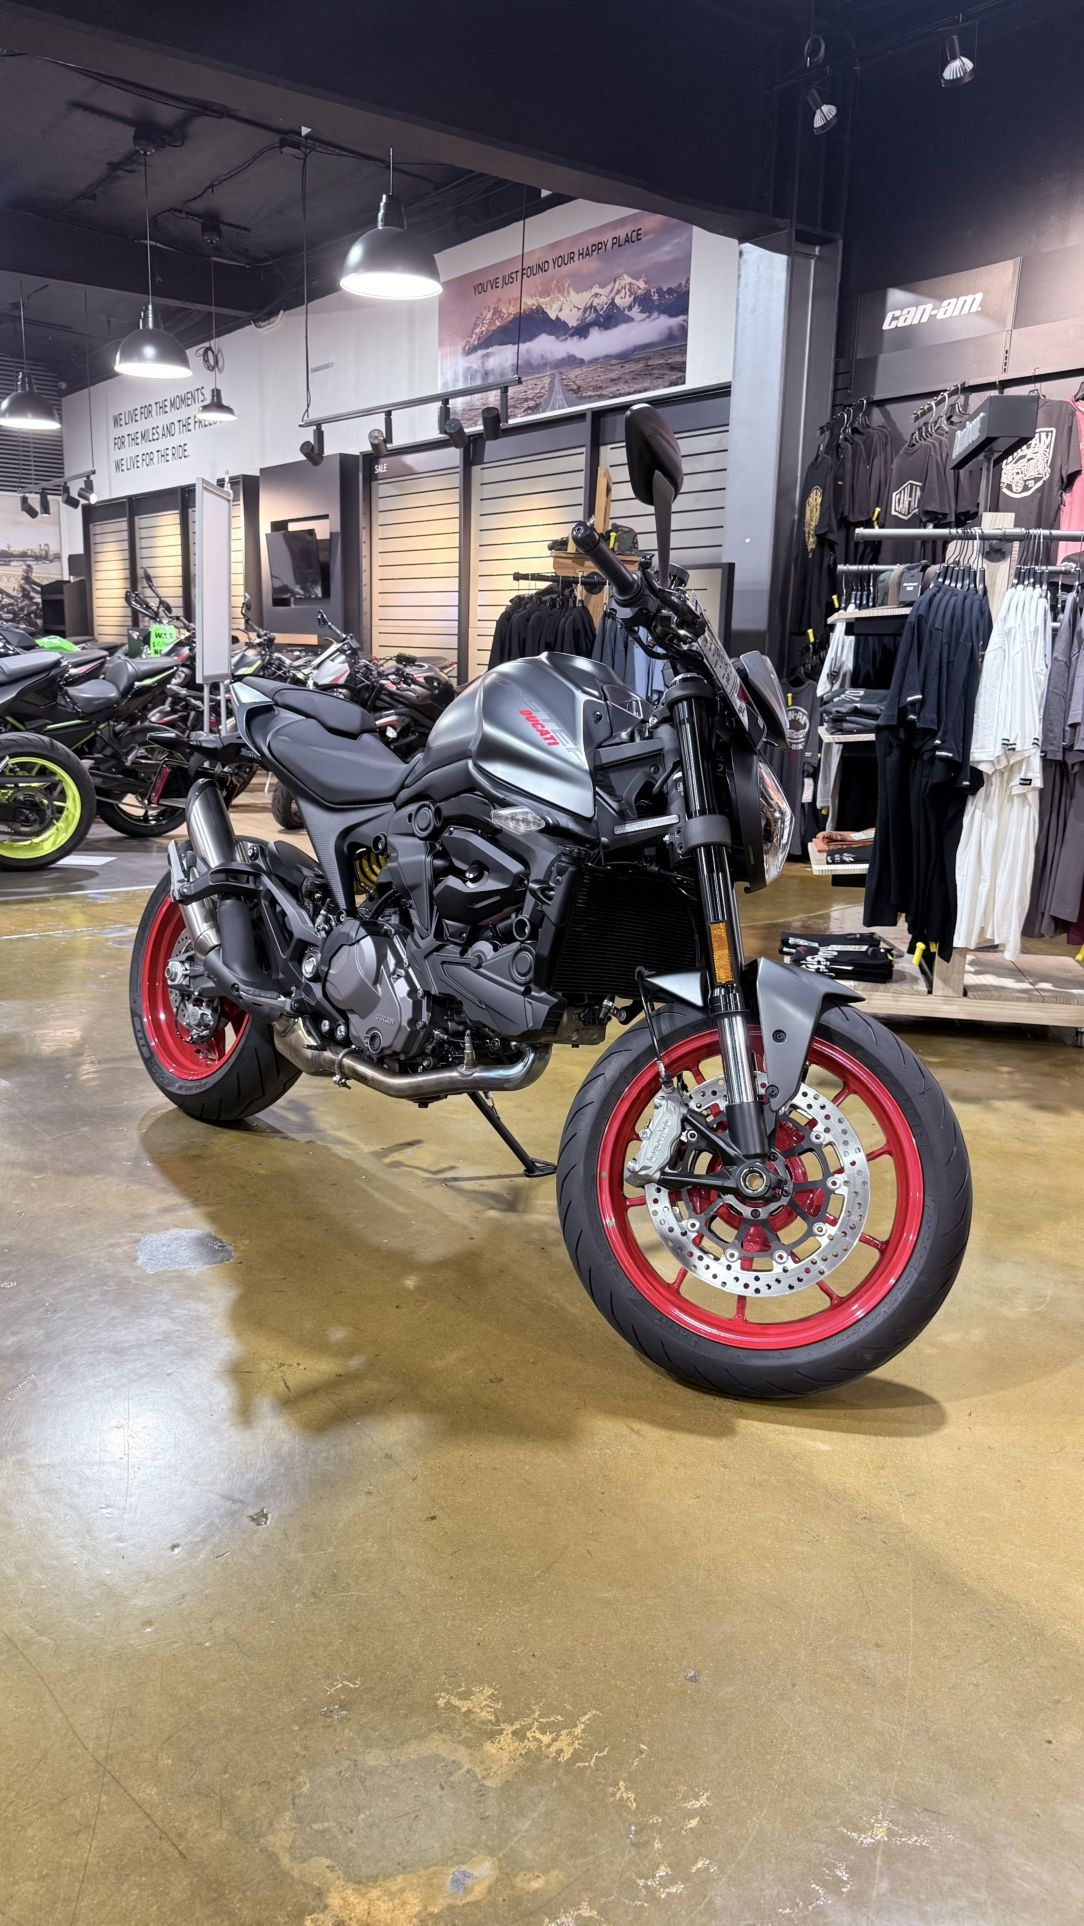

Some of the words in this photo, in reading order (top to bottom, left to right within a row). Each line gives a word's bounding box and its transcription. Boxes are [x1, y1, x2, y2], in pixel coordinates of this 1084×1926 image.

[473, 277, 499, 295] YOU'VE
[501, 270, 520, 289] JUST
[521, 260, 550, 279] FOUND
[551, 251, 576, 270] YOUR
[577, 239, 609, 262] HAPPY
[611, 227, 643, 250] PLACE
[112, 412, 123, 429] WE
[124, 408, 139, 426] LIVE
[140, 403, 153, 421] FOR
[154, 399, 169, 417] THE
[169, 386, 207, 412] MOMENTS.
[113, 437, 126, 451] FOR
[126, 431, 140, 448] THE
[140, 426, 160, 444] MILES
[161, 421, 176, 440] AND
[177, 416, 192, 436] THE
[114, 458, 125, 473] WE
[125, 455, 140, 471] LIVE
[141, 451, 155, 468] FOR
[156, 447, 170, 465] THE
[171, 443, 190, 462] RIDE.
[374, 463, 389, 474] SALE
[518, 708, 561, 747] DUCATI
